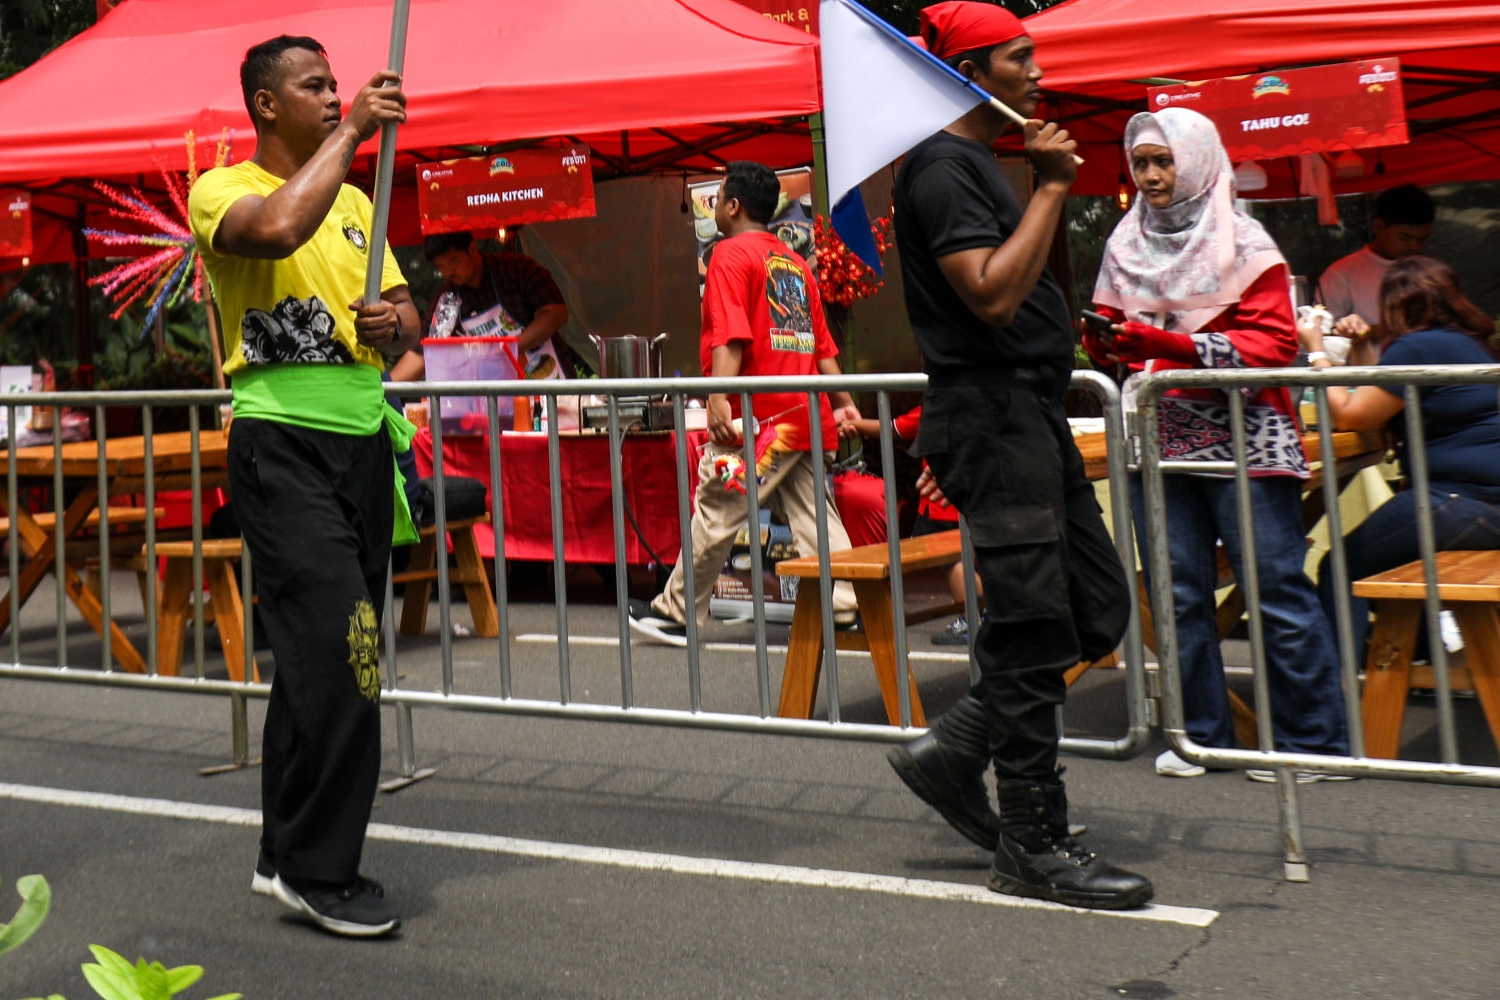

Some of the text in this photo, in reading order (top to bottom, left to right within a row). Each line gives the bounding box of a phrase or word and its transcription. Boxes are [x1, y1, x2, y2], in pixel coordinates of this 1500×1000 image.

[1240, 113, 1310, 132] TAHU GO!
[466, 187, 544, 206] REDHA KITCHEN
